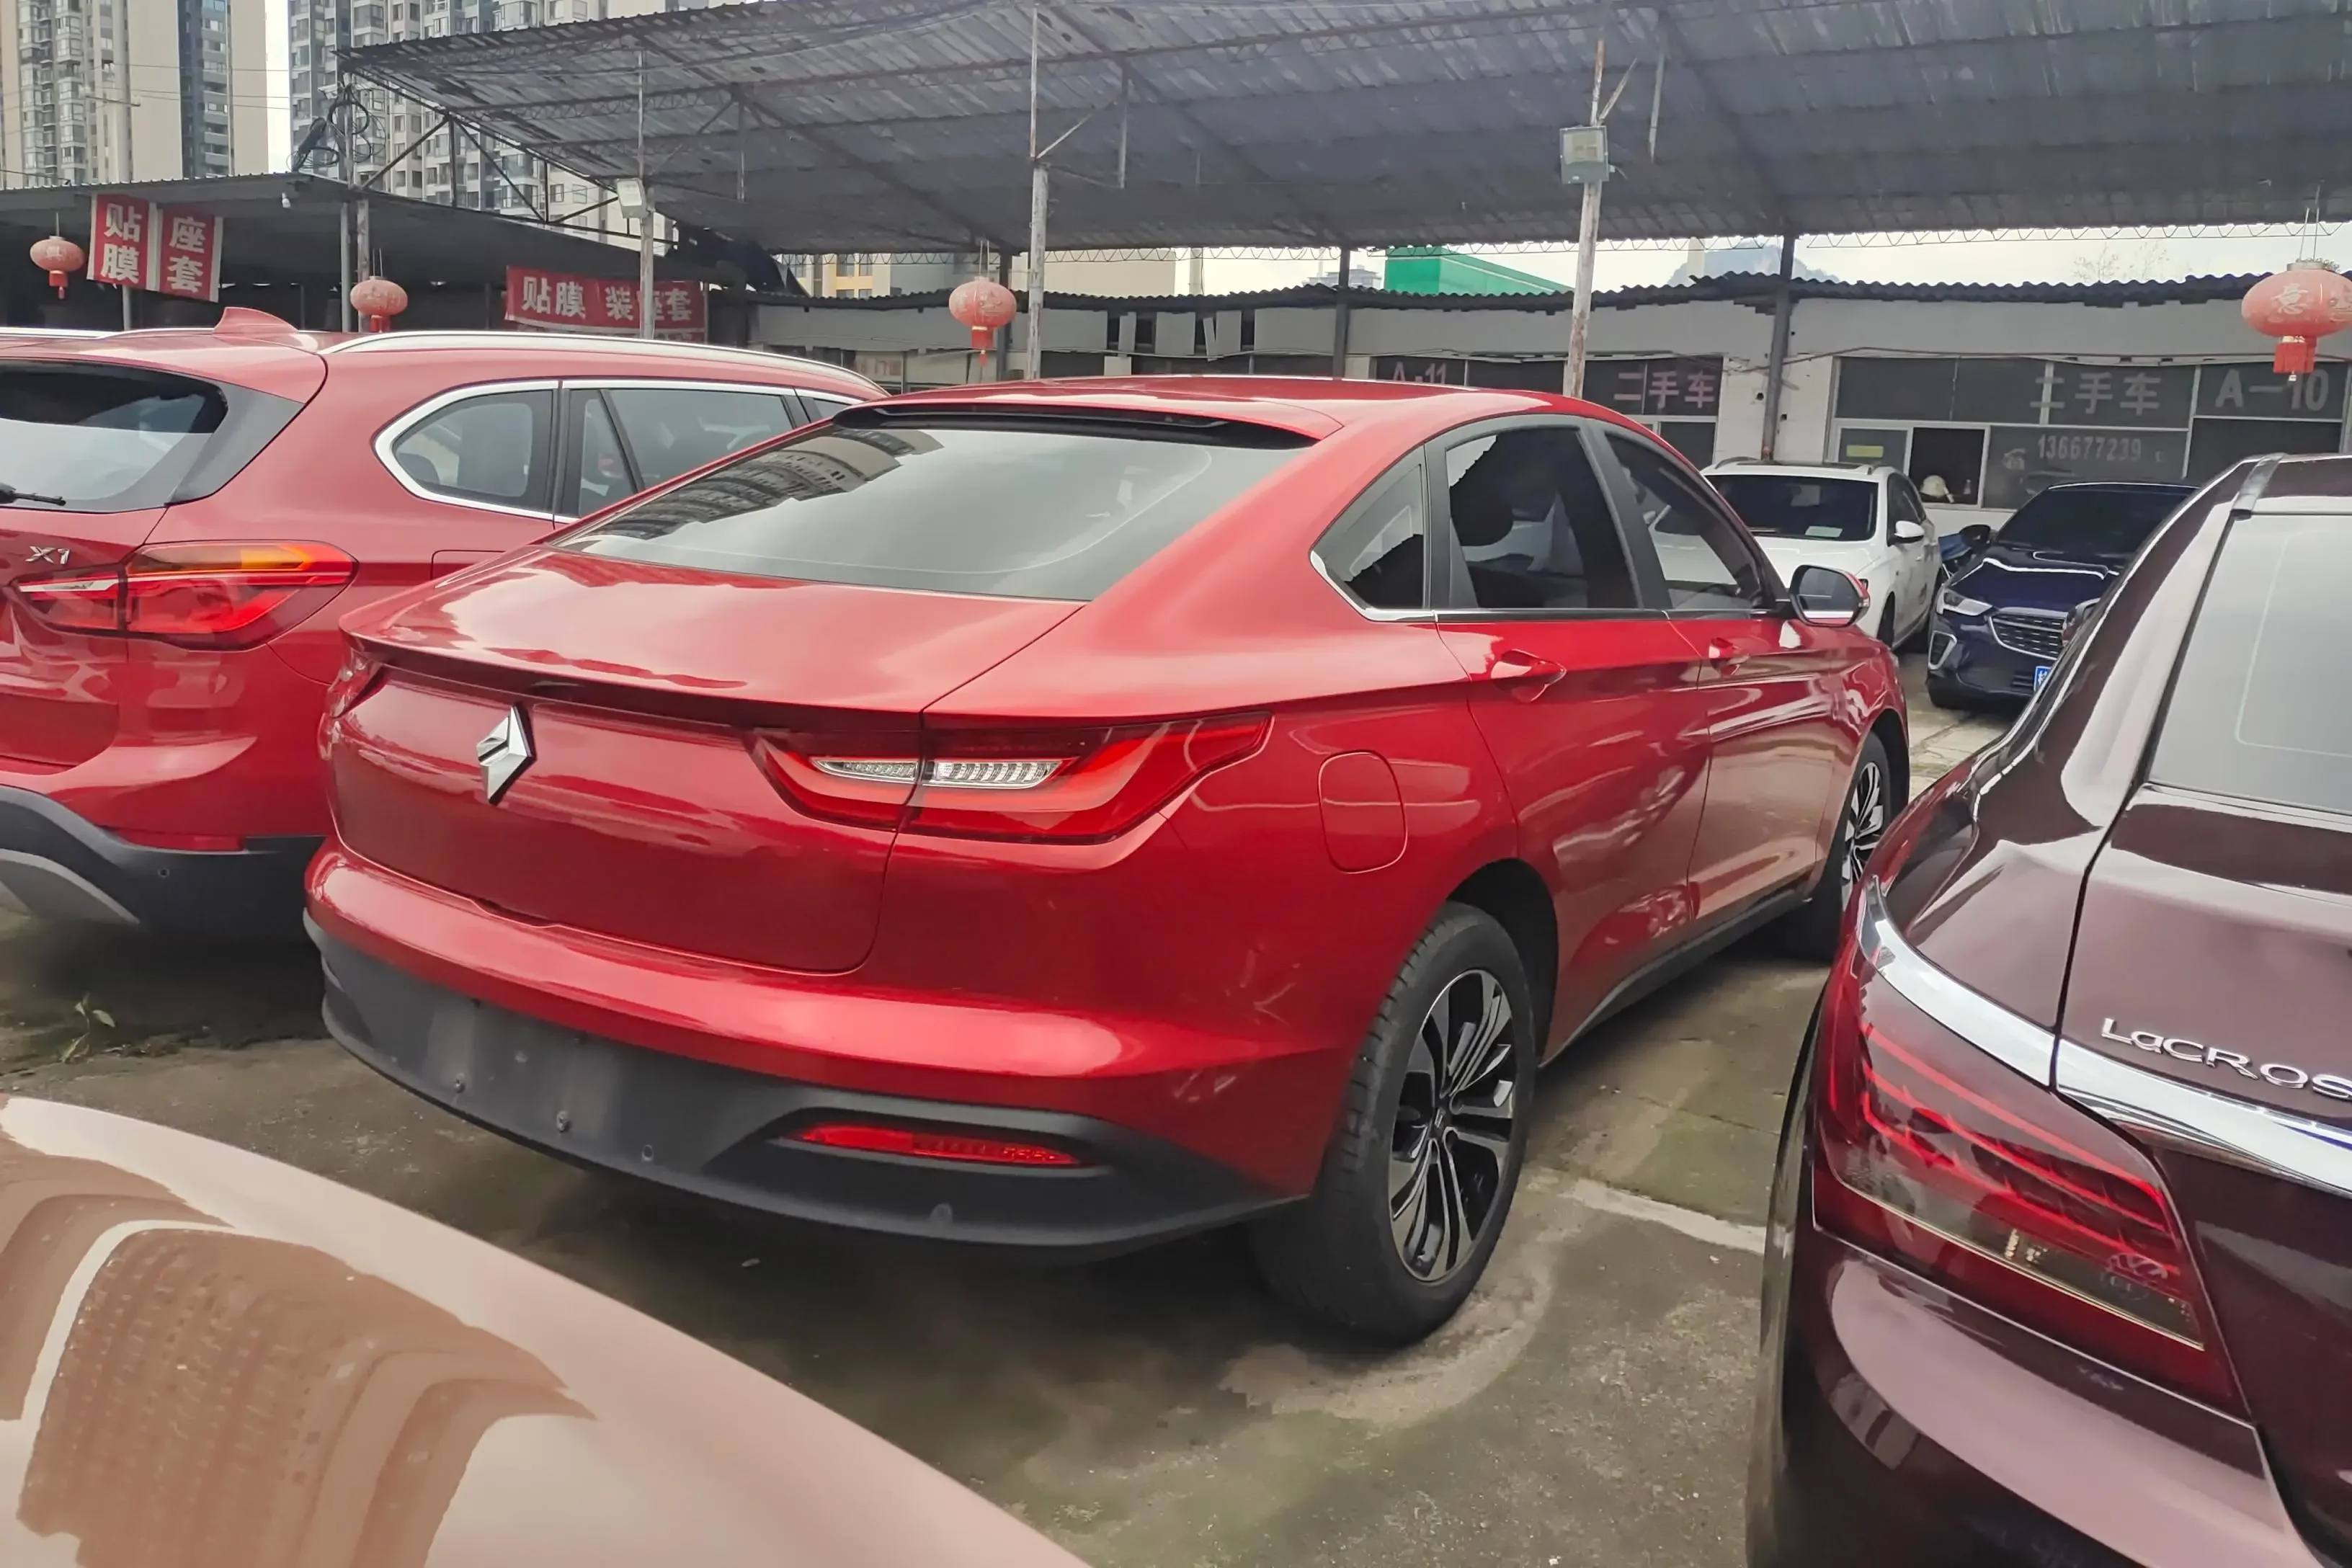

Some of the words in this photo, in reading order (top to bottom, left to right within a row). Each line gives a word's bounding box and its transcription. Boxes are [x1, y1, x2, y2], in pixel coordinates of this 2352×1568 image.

[100, 203, 142, 284] 贴膜
[167, 217, 206, 293] 座套
[521, 276, 586, 320] 贴膜
[1613, 370, 1716, 409] 二手车
[2030, 372, 2161, 416] 二手车
[24, 545, 70, 564] X1
